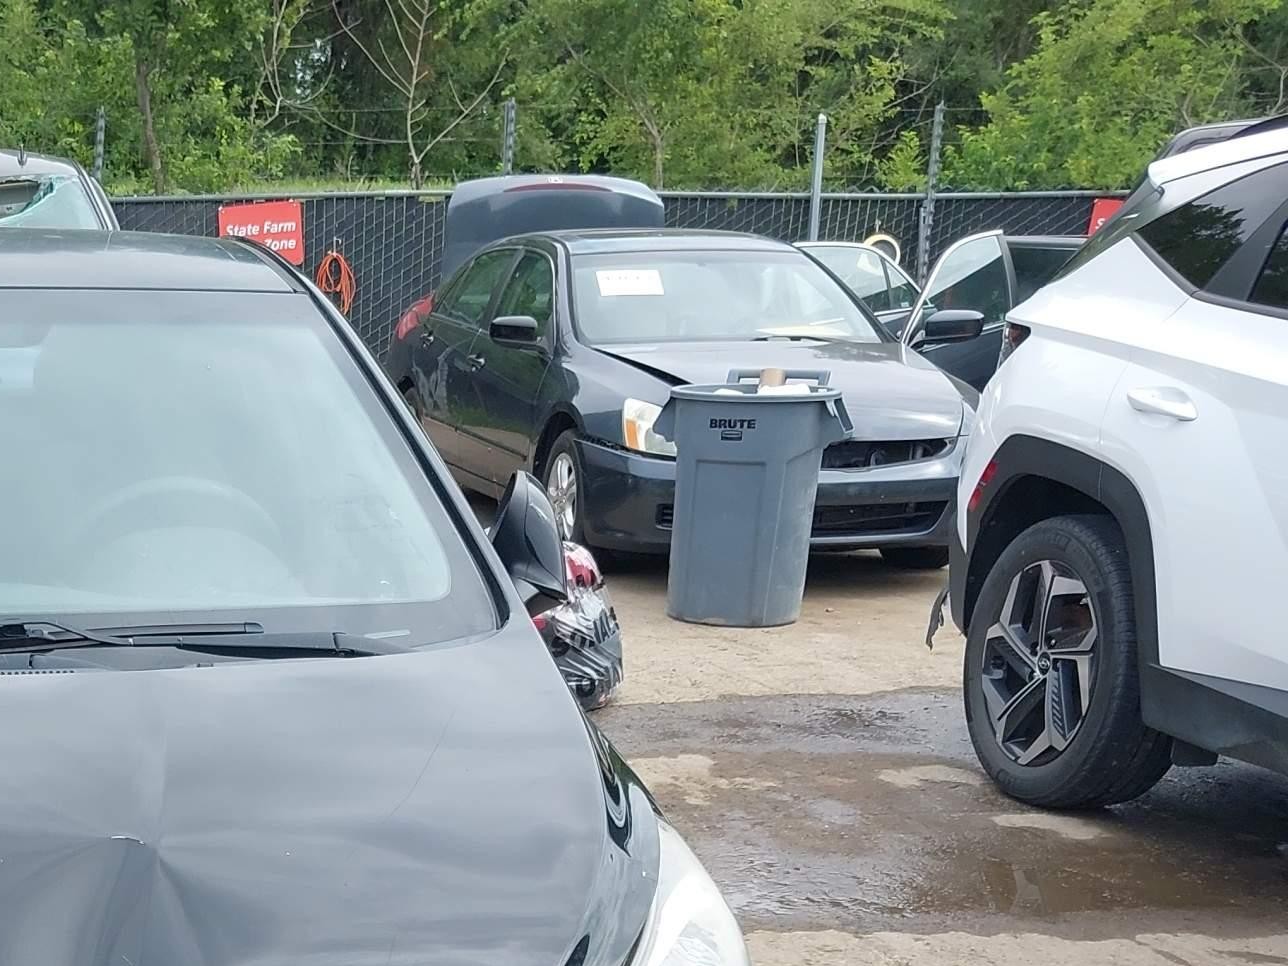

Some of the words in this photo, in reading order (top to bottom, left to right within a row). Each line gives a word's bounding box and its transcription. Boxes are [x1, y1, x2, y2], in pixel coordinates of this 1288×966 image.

[226, 224, 260, 237] State
[263, 221, 297, 235] Farm
[709, 418, 757, 429] BRUTE
